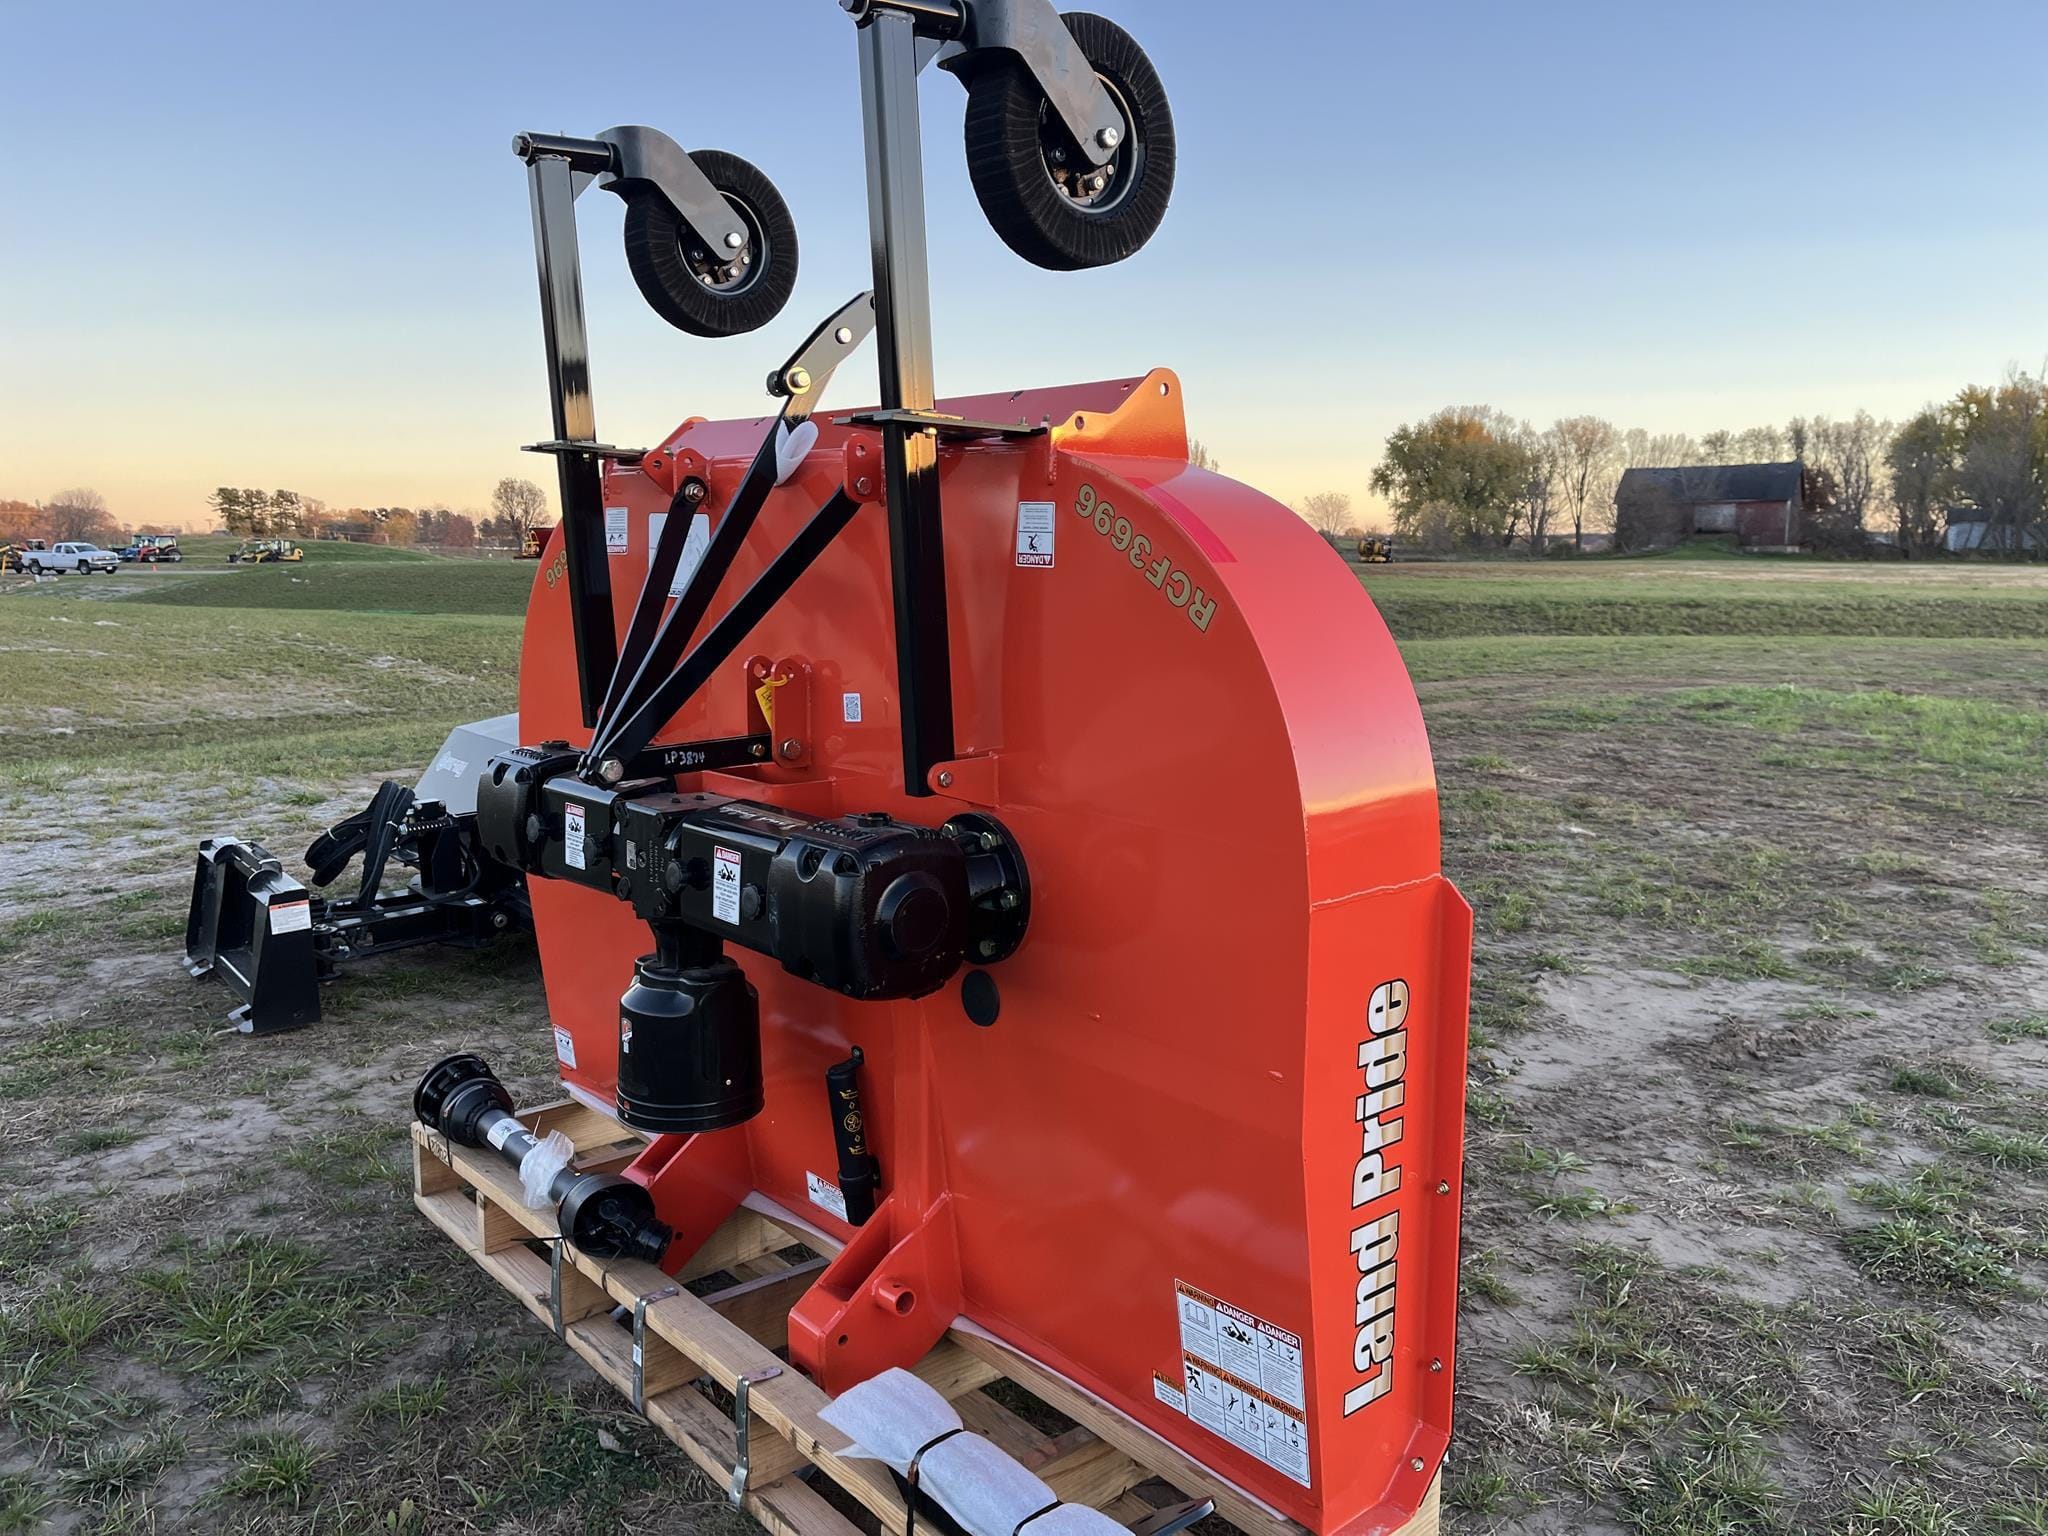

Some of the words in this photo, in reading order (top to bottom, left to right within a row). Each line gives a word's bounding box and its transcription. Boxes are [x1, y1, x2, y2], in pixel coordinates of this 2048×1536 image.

[1018, 554, 1044, 565] DANGER
[1074, 483, 1218, 633] RCF3696
[1351, 978, 1411, 1209] Pride
[1185, 1286, 1215, 1307] WARNING
[1223, 1305, 1255, 1327] DANGER
[1343, 1207, 1400, 1419] Land
[1265, 1324, 1298, 1347] DANGER
[1192, 1356, 1222, 1378] WARNING
[1230, 1376, 1261, 1398] WARNING
[1271, 1399, 1303, 1420] WARNING
